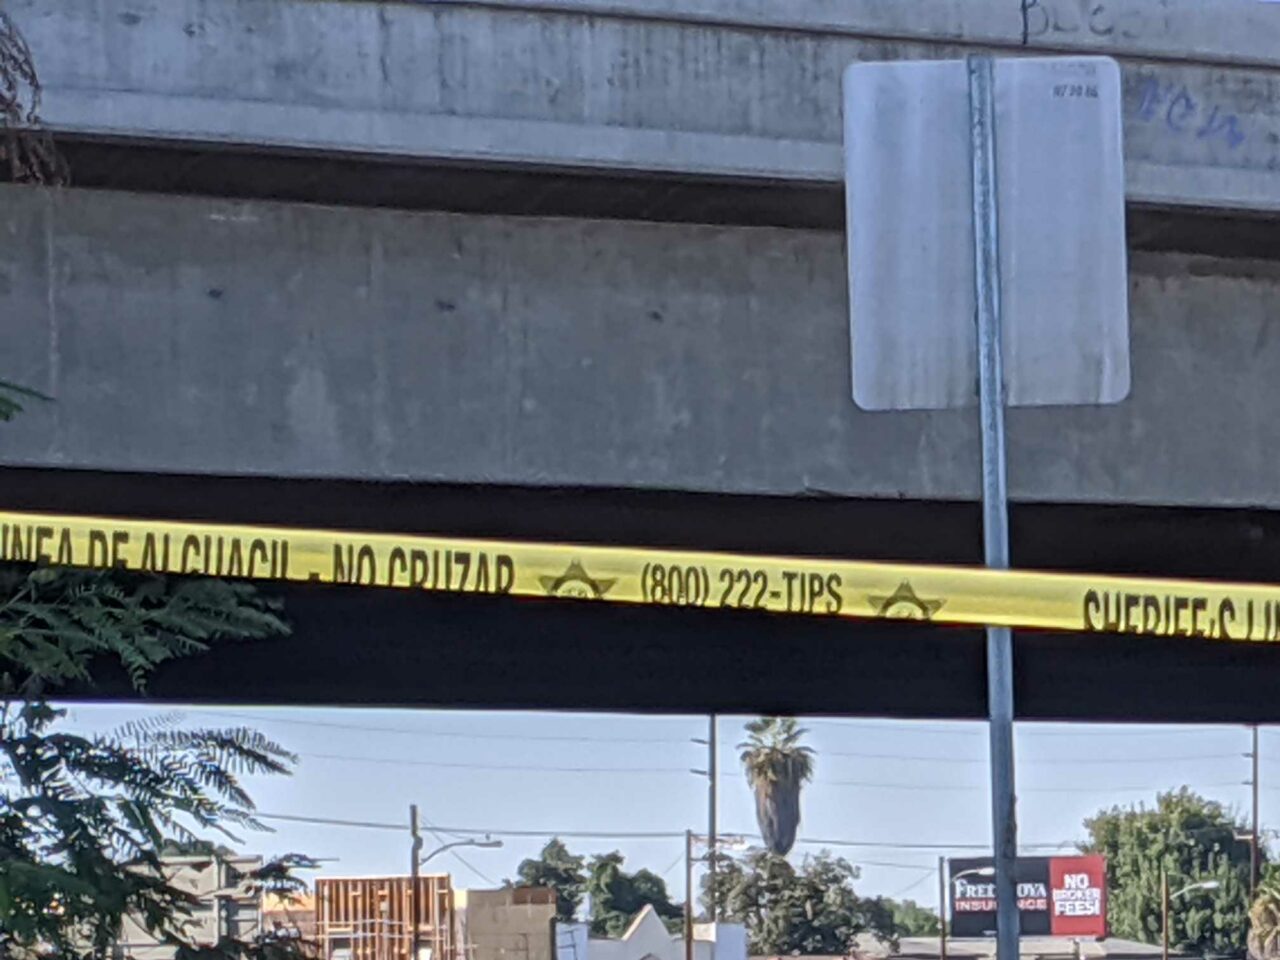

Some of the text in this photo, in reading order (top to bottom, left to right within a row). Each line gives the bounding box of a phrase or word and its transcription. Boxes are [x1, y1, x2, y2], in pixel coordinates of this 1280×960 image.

[640, 562, 843, 614] (800) 222-TIPS
[1063, 873, 1090, 889] NO
[1015, 882, 1047, 898] OYA
